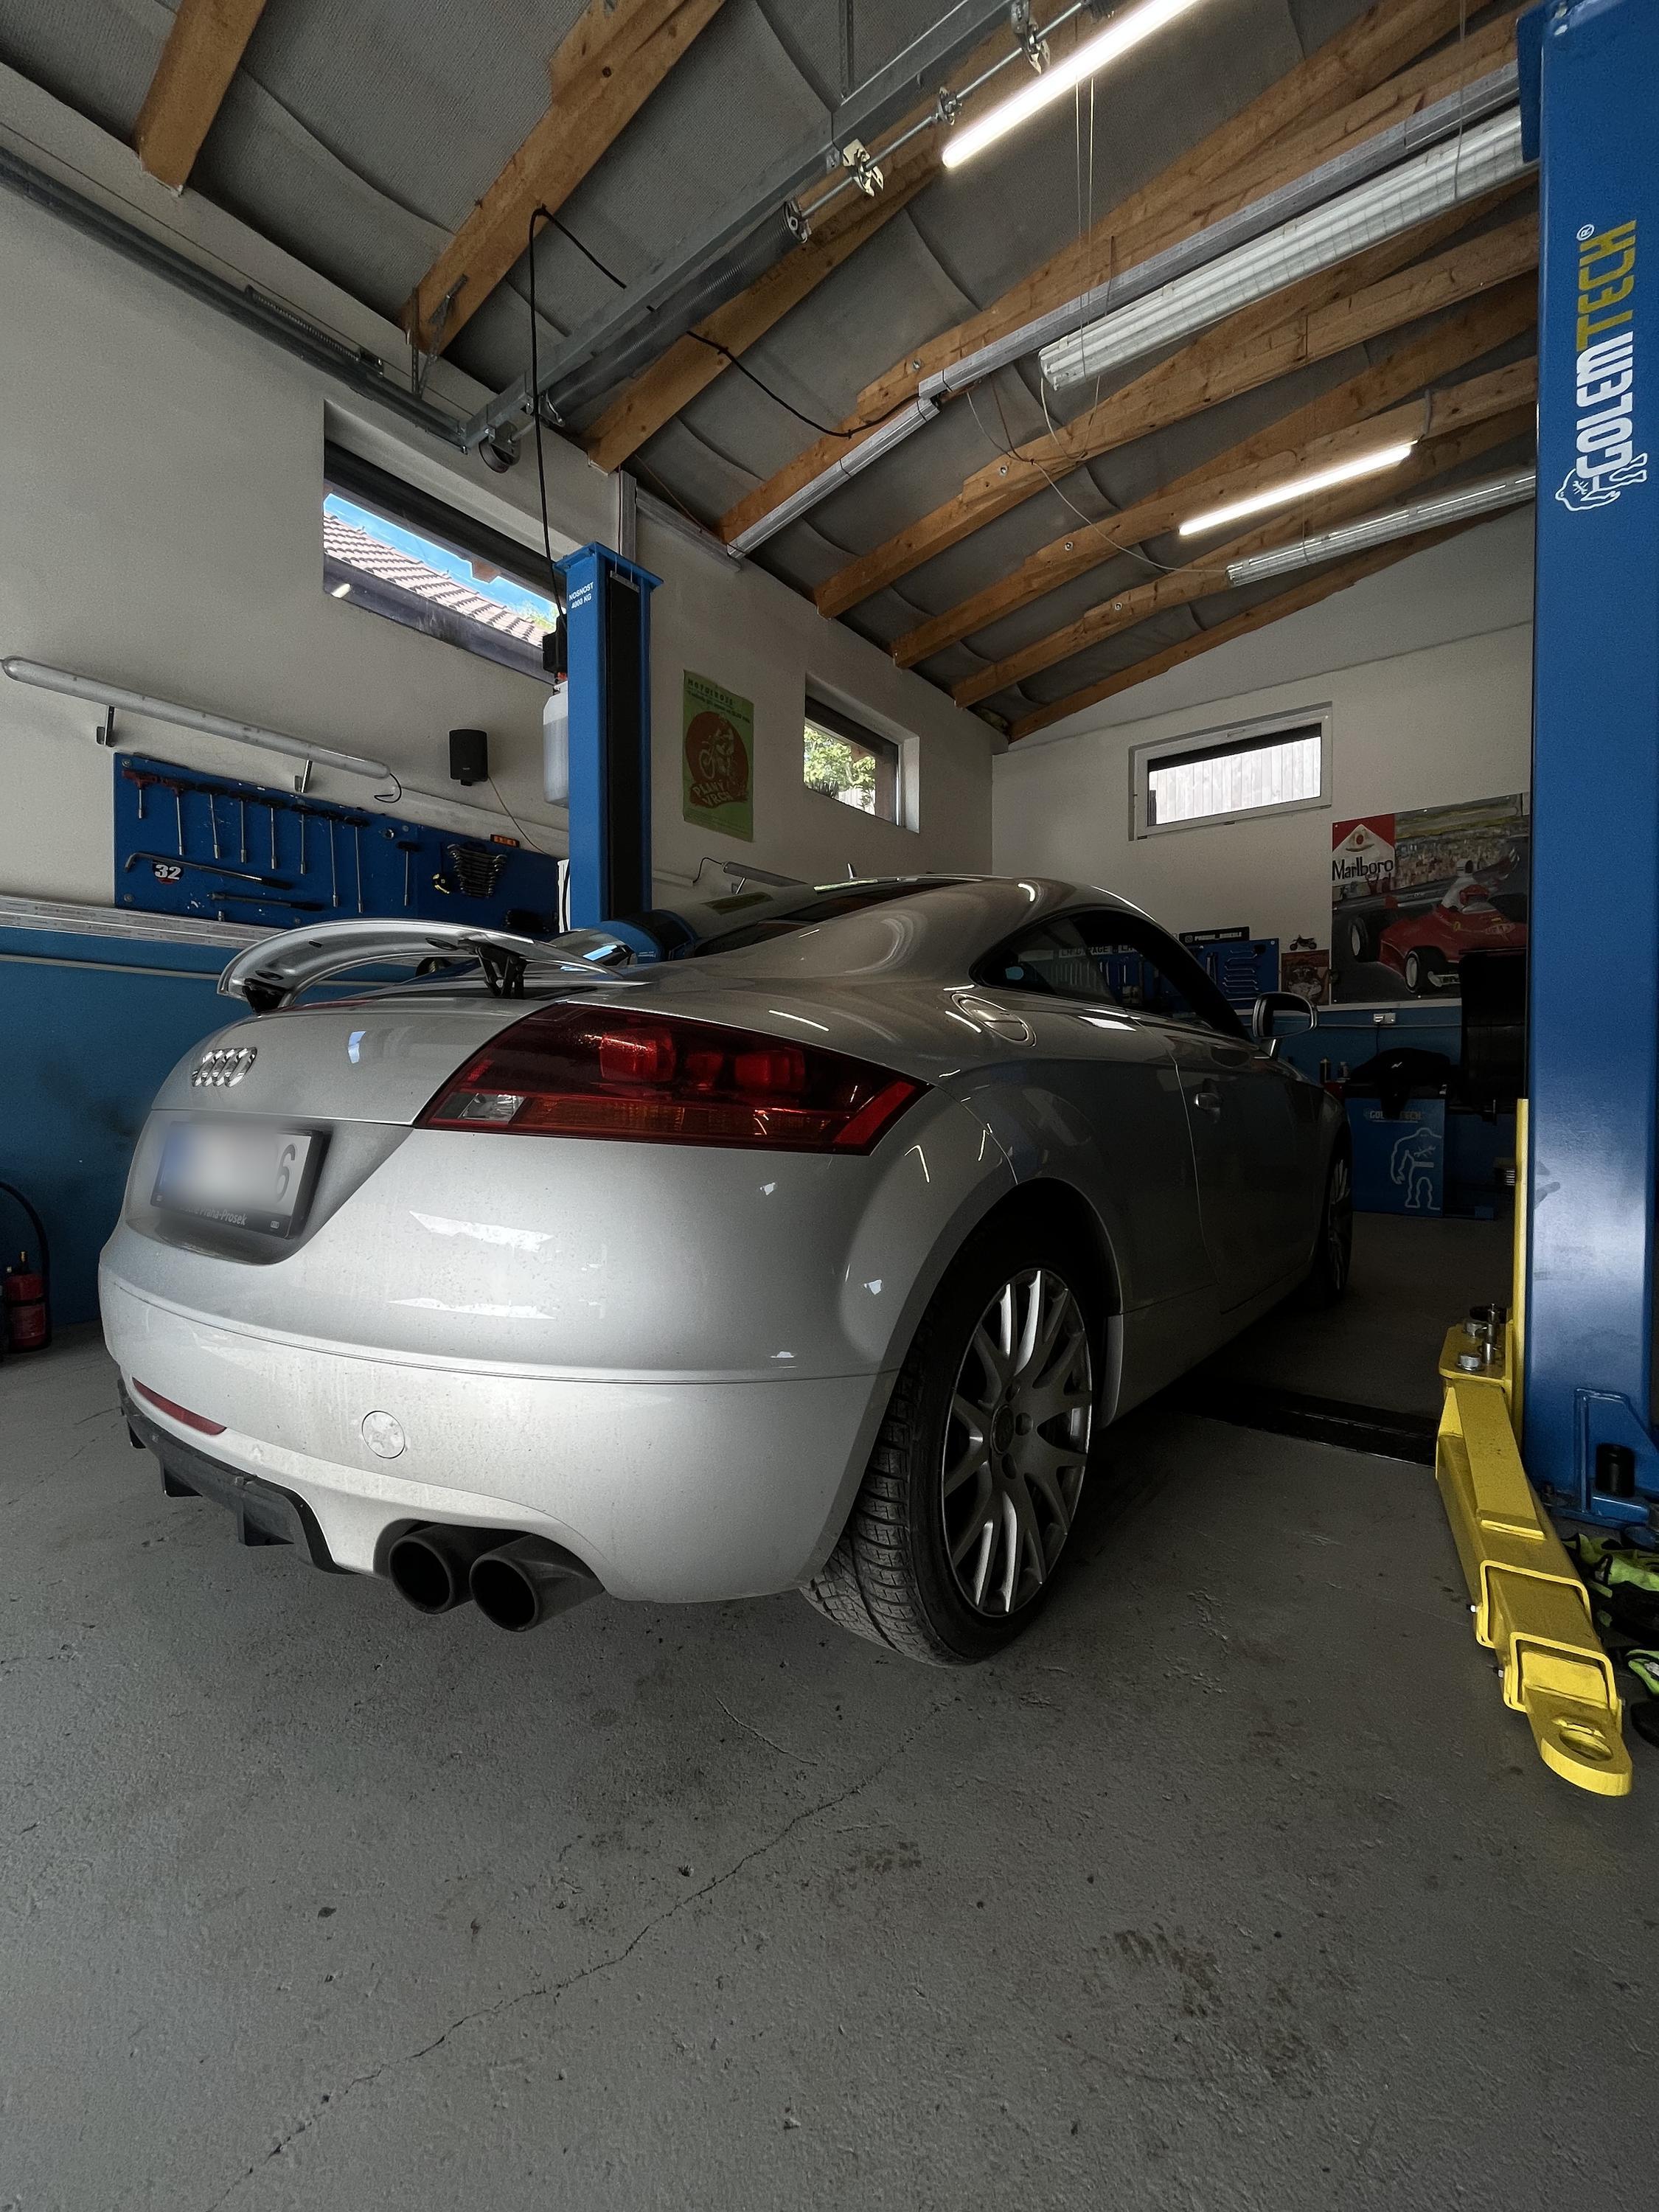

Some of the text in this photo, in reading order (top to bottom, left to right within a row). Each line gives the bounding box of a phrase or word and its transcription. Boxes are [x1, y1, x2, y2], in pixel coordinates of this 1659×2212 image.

[568, 582, 594, 602] NOSNOST
[571, 593, 592, 609] 4000 KG
[154, 863, 181, 880] 32
[1332, 856, 1394, 881] Marlboro
